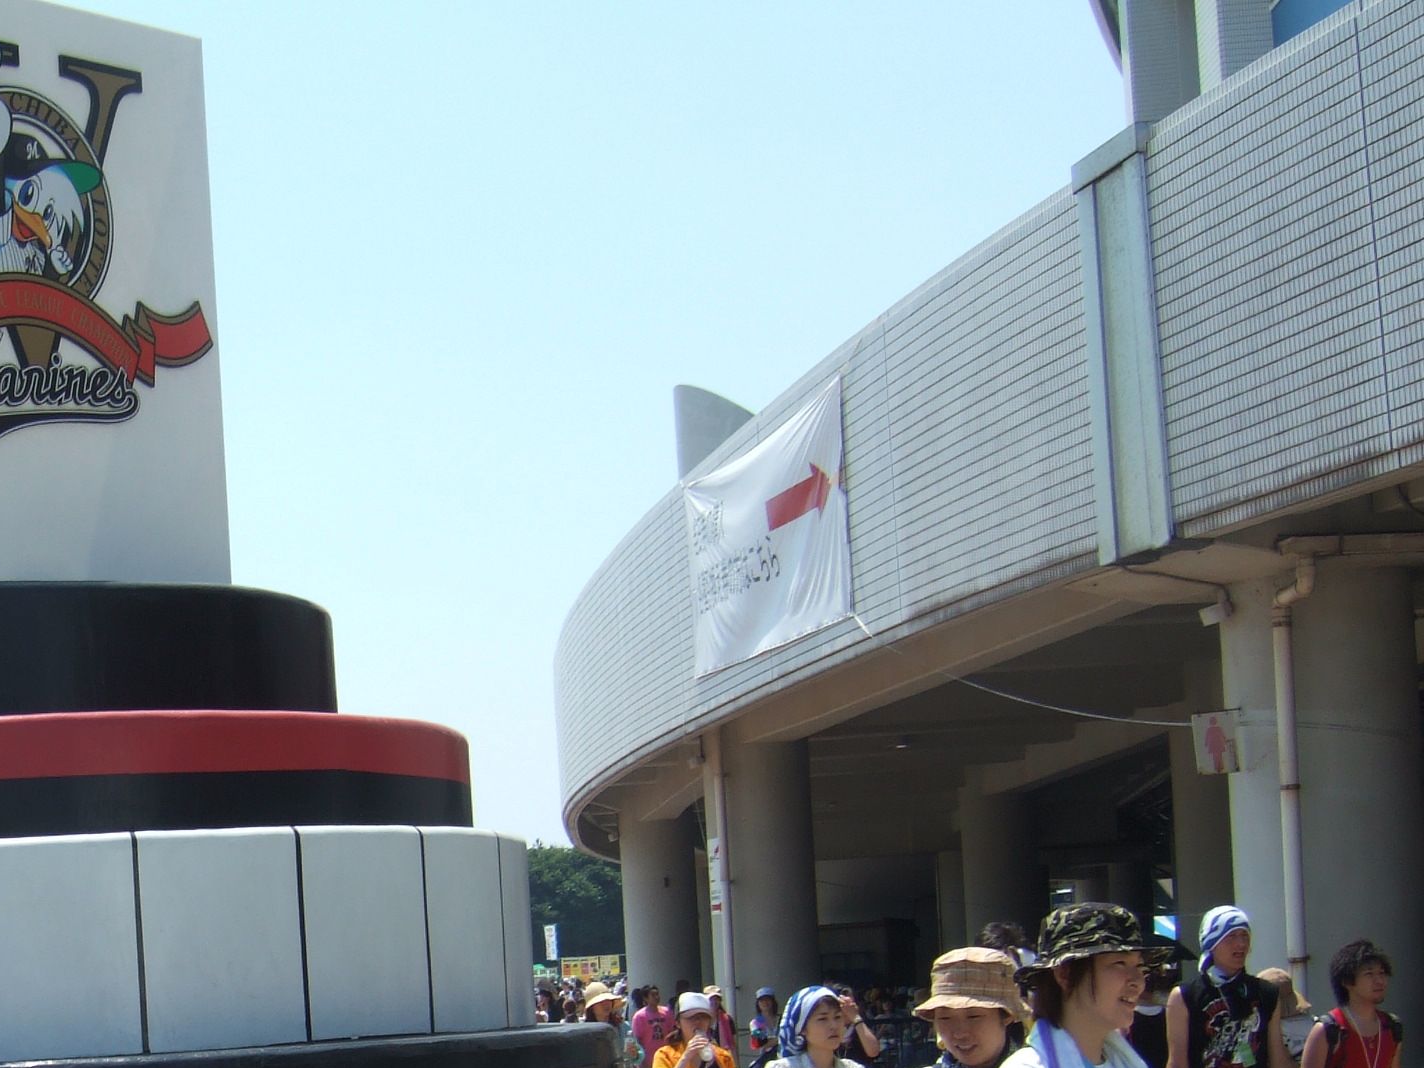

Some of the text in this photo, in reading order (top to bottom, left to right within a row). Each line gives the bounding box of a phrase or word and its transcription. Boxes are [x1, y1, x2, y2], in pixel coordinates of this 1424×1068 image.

[8, 91, 80, 152] CHIBA
[76, 197, 107, 294] LOTTE
[15, 288, 63, 317] LEAGUE
